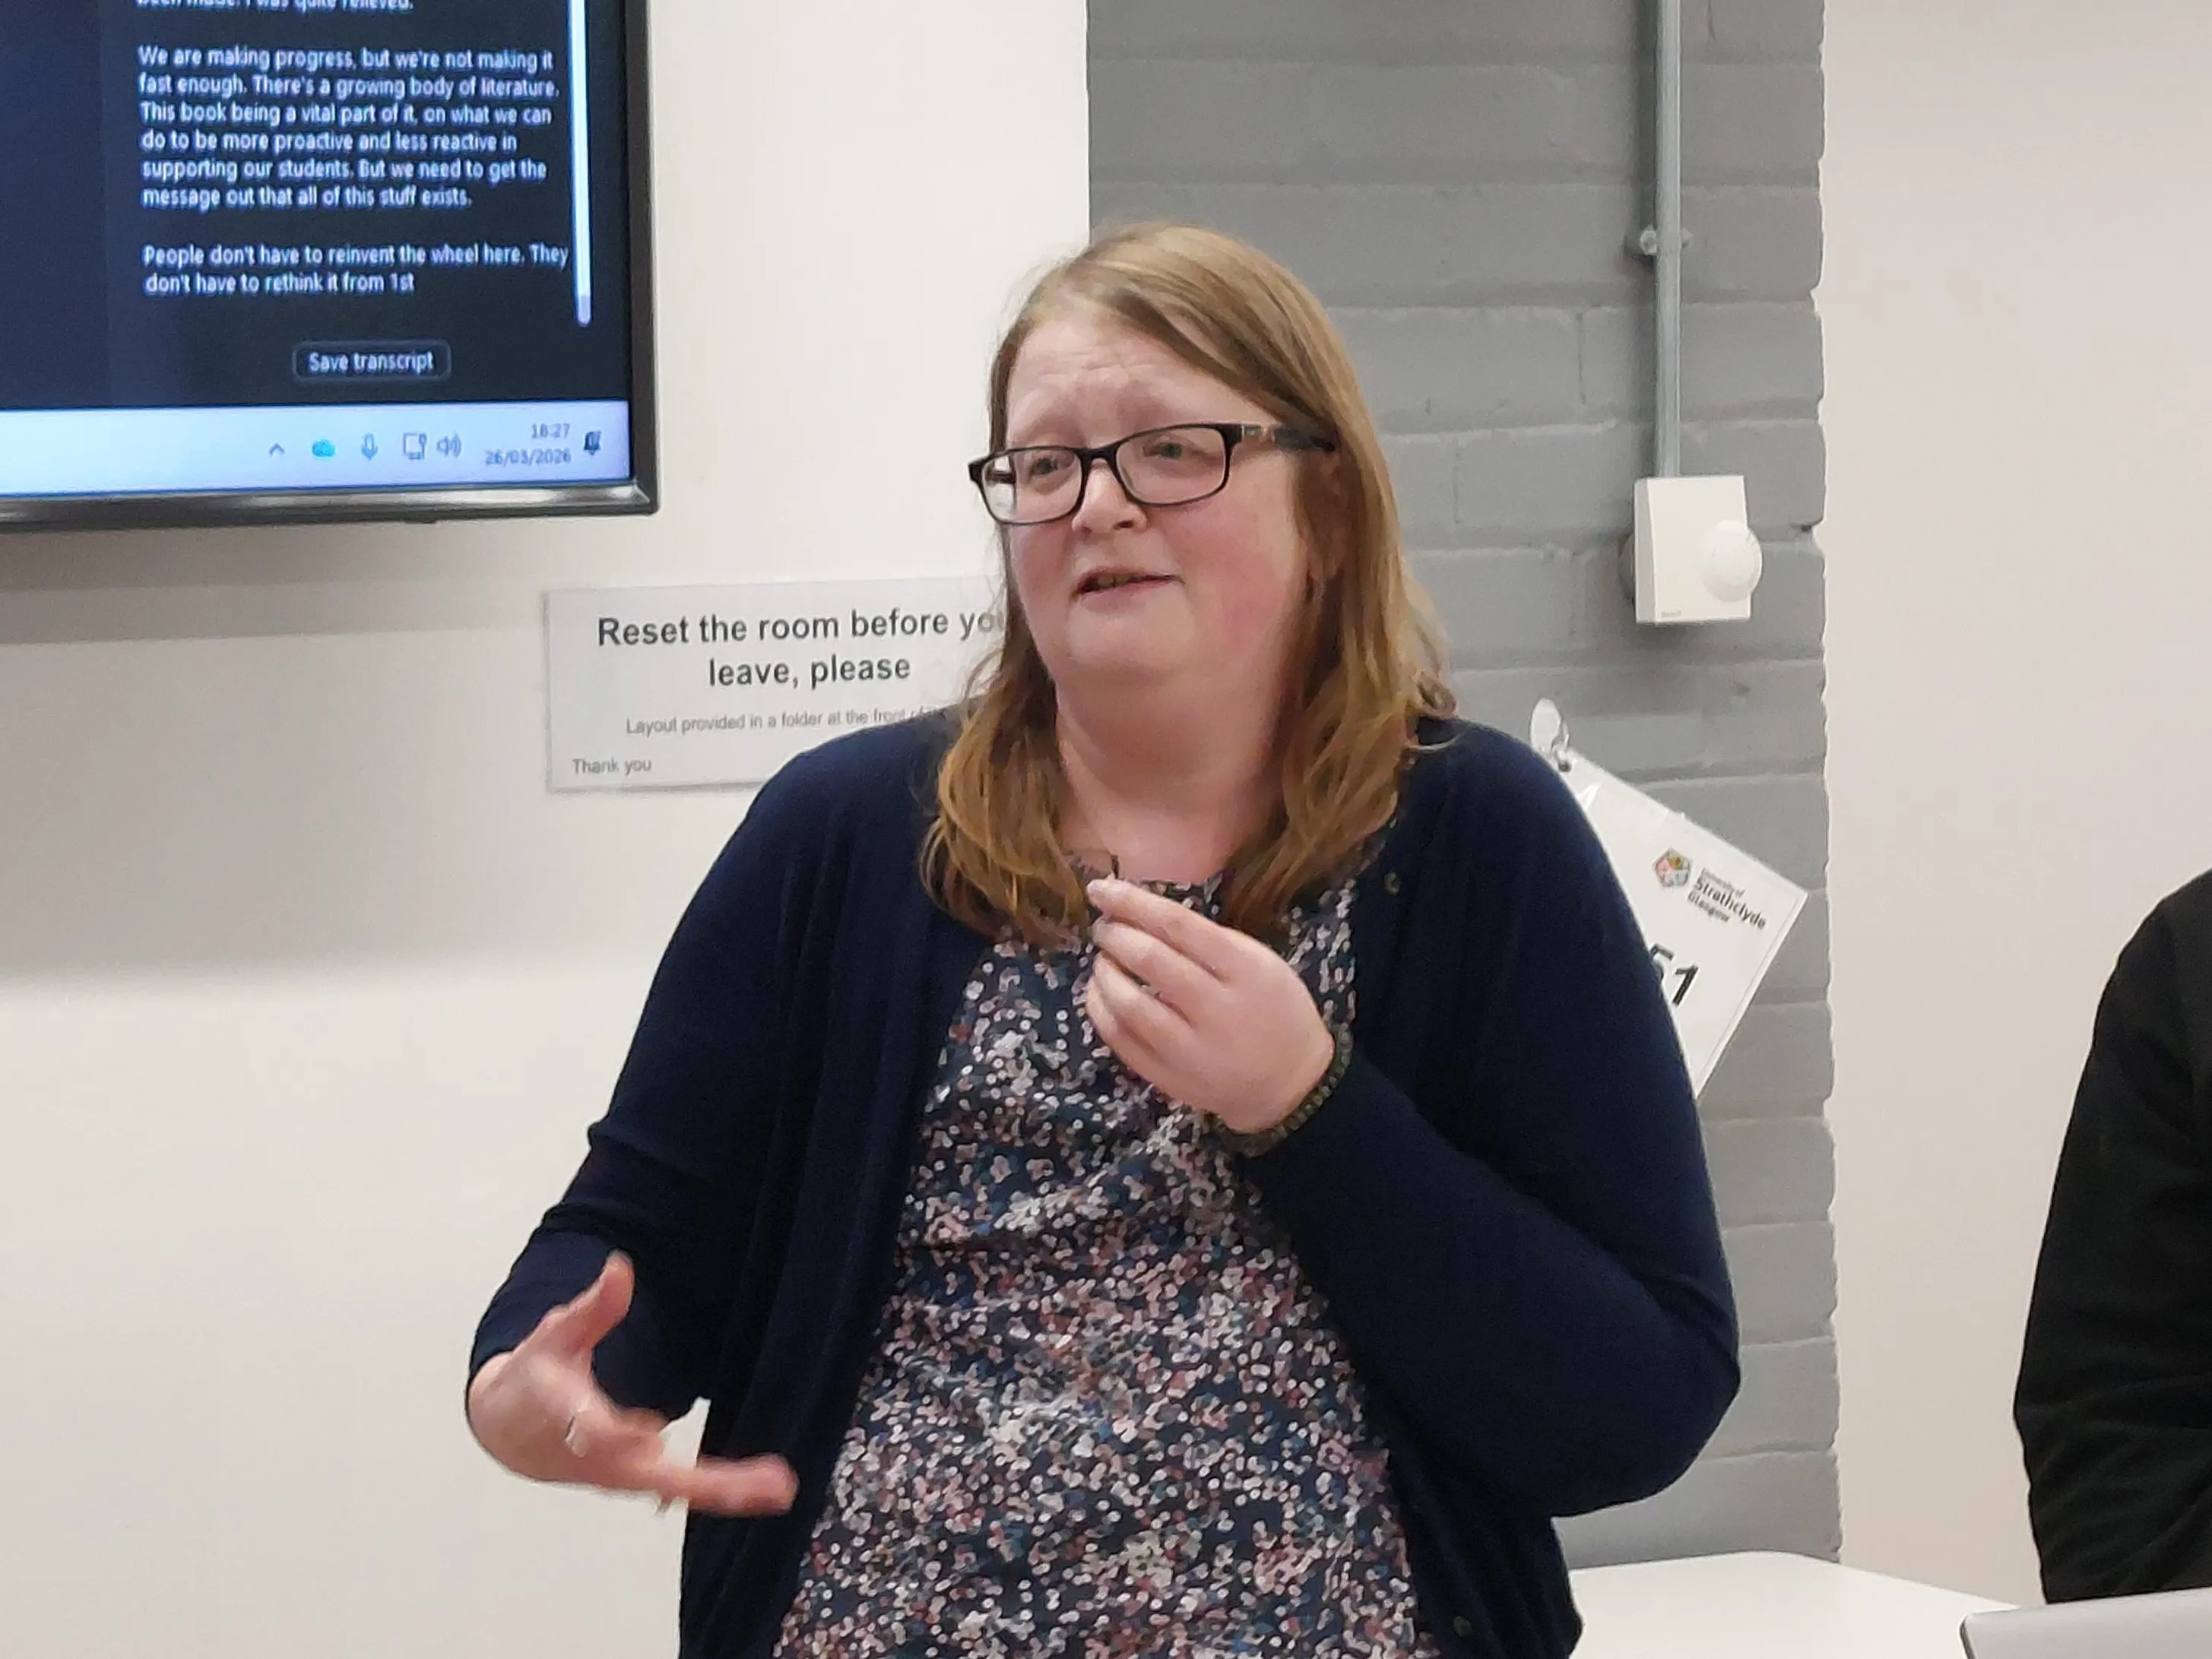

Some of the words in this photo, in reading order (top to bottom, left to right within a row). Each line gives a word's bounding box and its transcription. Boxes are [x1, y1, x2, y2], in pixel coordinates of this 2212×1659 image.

[138, 46, 168, 66] We
[173, 50, 202, 66] are
[208, 46, 271, 70] making
[275, 49, 357, 72] progress,
[362, 47, 390, 68] but
[395, 50, 440, 69] we're
[445, 49, 473, 69] not
[477, 49, 538, 74] making
[542, 49, 554, 70] it
[138, 73, 172, 93] fast
[176, 74, 247, 99] enough.
[252, 74, 314, 96] There's
[319, 79, 331, 96] a
[336, 78, 405, 100] growing
[410, 75, 455, 100] body
[459, 76, 477, 97] of
[141, 102, 176, 122] This
[179, 102, 227, 122] book
[230, 102, 280, 127] being
[285, 106, 296, 123] a
[302, 103, 336, 123] vital
[341, 105, 376, 127] part
[382, 103, 398, 124] of
[423, 108, 446, 124] on
[451, 105, 490, 125] what
[494, 109, 518, 125] we
[522, 108, 552, 125] can
[142, 129, 166, 150] do
[171, 131, 189, 150] to
[195, 130, 217, 150] be
[223, 135, 268, 150] more
[274, 131, 353, 156] proactive
[359, 131, 391, 150] and
[395, 131, 428, 151] less
[433, 131, 497, 151] reactive
[502, 131, 518, 151] in
[142, 159, 238, 184] supporting
[243, 161, 273, 178] our
[358, 159, 385, 179] But
[390, 163, 414, 179] we
[419, 158, 461, 179] need
[465, 160, 484, 179] to
[488, 160, 515, 185] get
[520, 158, 547, 179] the
[142, 189, 220, 212] message
[227, 189, 255, 205] out
[259, 186, 293, 205] that
[297, 186, 318, 204] all
[322, 186, 341, 204] of
[344, 187, 375, 206] this
[380, 185, 417, 206] stuff
[143, 244, 204, 268] People
[210, 244, 255, 264] don't
[259, 244, 299, 264] have
[304, 246, 323, 264] to
[328, 245, 395, 264] reinvent
[399, 244, 426, 264] the
[431, 243, 478, 264] wheel
[529, 242, 569, 272] They
[145, 272, 190, 293] don't
[195, 272, 236, 293] have
[240, 274, 260, 293] to
[264, 272, 323, 293] rethink
[327, 274, 338, 293] it
[343, 271, 385, 293] from
[391, 272, 414, 293] 1st
[309, 352, 348, 373] Save
[353, 350, 434, 375] transcript
[598, 616, 689, 646] Reset
[699, 614, 747, 643] the
[759, 617, 839, 641] room
[851, 608, 949, 638] before
[709, 657, 799, 689] leave,
[811, 654, 911, 690] please
[626, 717, 677, 738] Layout
[681, 714, 745, 736] provided
[750, 714, 762, 728] in
[768, 716, 776, 727] a
[782, 711, 822, 728] folder
[828, 713, 841, 725] at
[846, 710, 868, 724] the
[572, 758, 619, 774] Thank
[624, 759, 651, 776] you
[1695, 876, 1767, 929] Strathclyde
